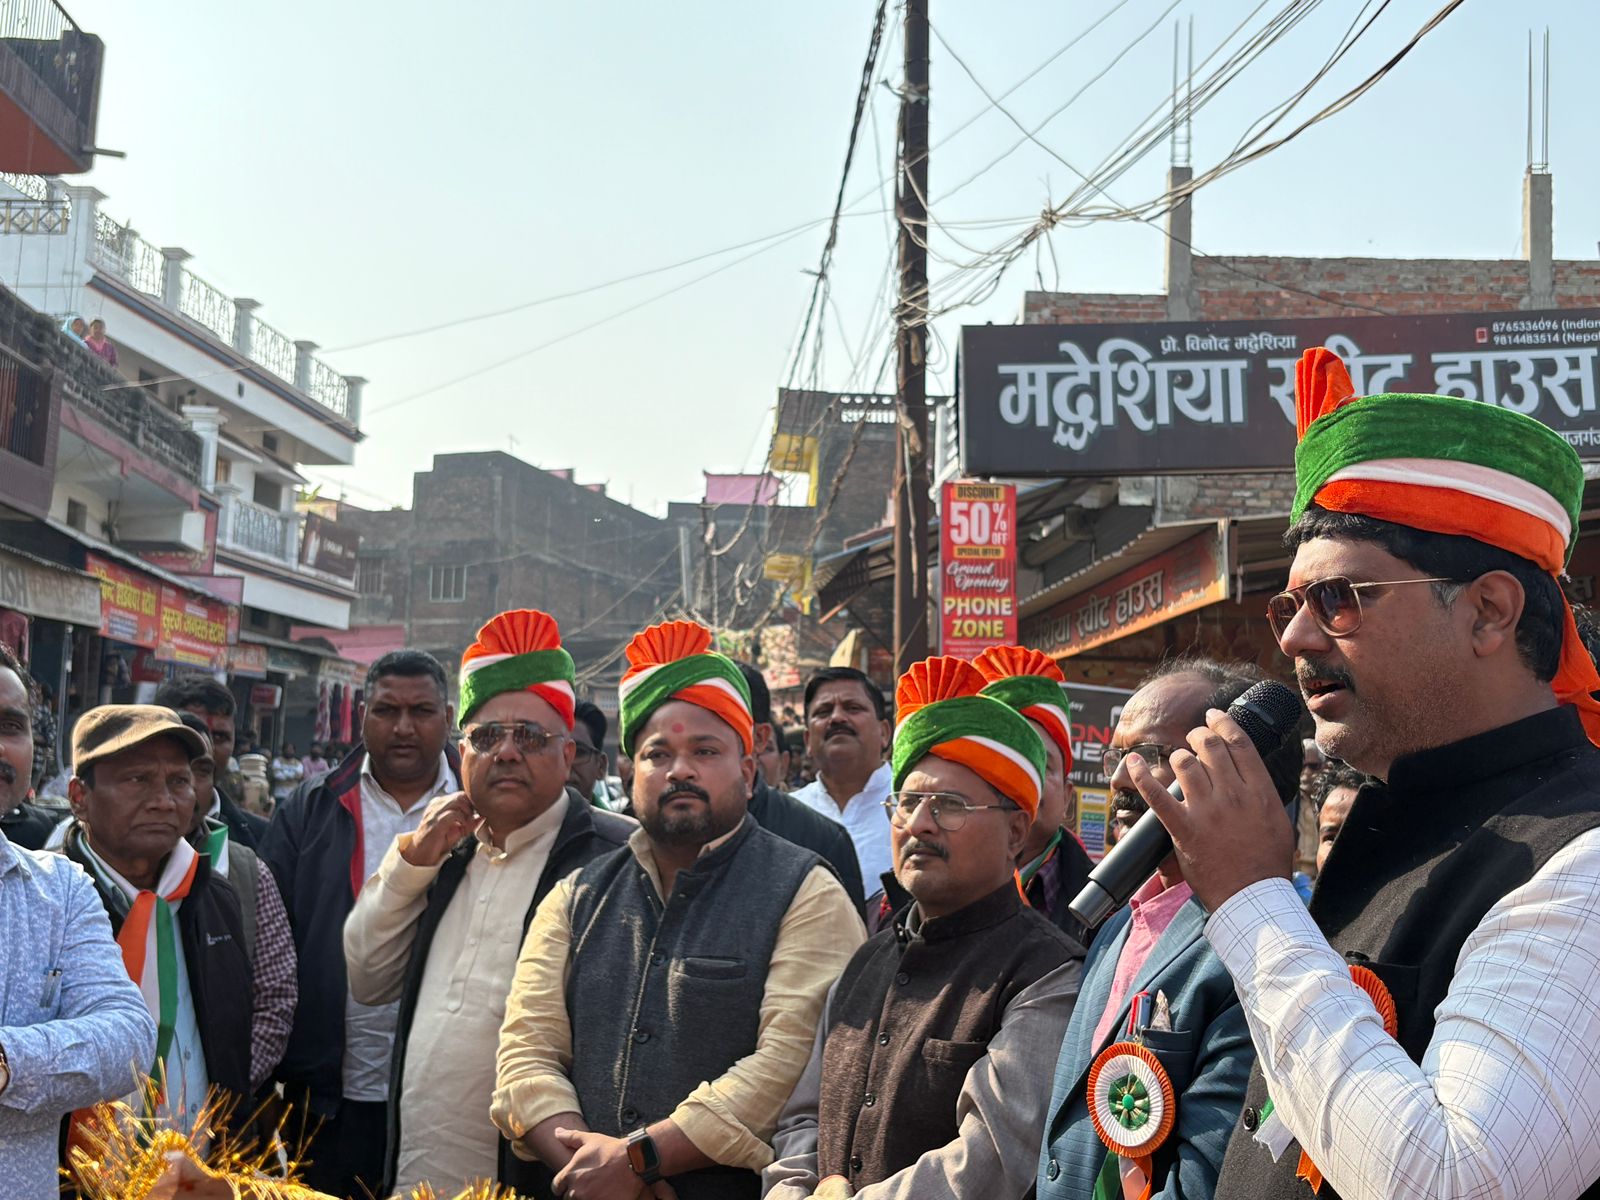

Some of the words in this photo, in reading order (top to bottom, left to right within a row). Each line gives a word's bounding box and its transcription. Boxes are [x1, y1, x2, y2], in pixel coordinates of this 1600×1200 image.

[1492, 319, 1558, 333] 8765336096
[1160, 335, 1181, 355] प्रो.
[1185, 333, 1231, 353] विनोद
[1493, 332, 1560, 346] 9814483514
[957, 487, 1000, 499] DISCOUNT
[949, 502, 1007, 545] 50%
[991, 532, 1008, 545] OFF
[946, 561, 995, 575] Grand
[954, 574, 1009, 593] Opening
[944, 597, 1012, 616] PHONE
[1076, 593, 1111, 639] स्वीट
[1115, 570, 1165, 626] हाउस
[951, 619, 1005, 638] ZONE
